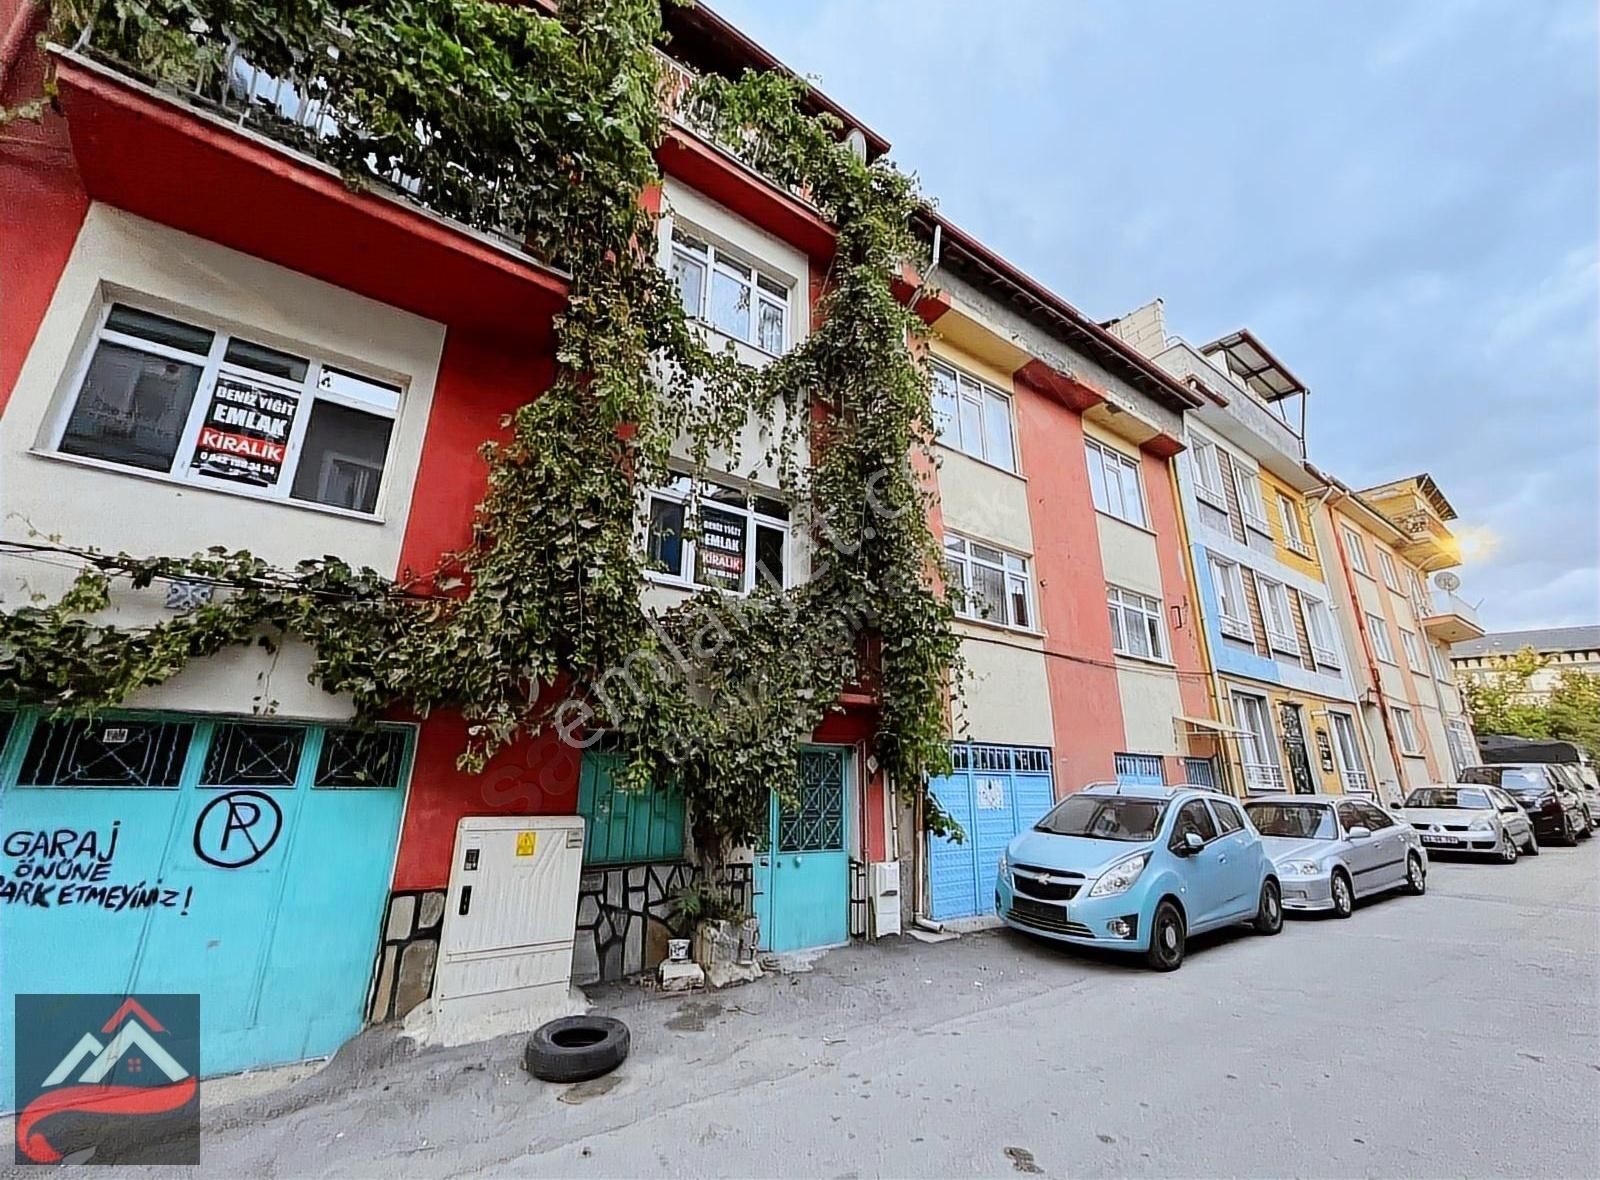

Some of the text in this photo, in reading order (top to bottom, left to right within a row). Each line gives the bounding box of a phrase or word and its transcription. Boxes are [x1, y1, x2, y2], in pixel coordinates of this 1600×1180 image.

[213, 403, 288, 437] EMLAK
[202, 431, 282, 461] KİRALIK
[705, 534, 740, 551] EMLAK
[15, 857, 112, 881] ÖNÜNE
